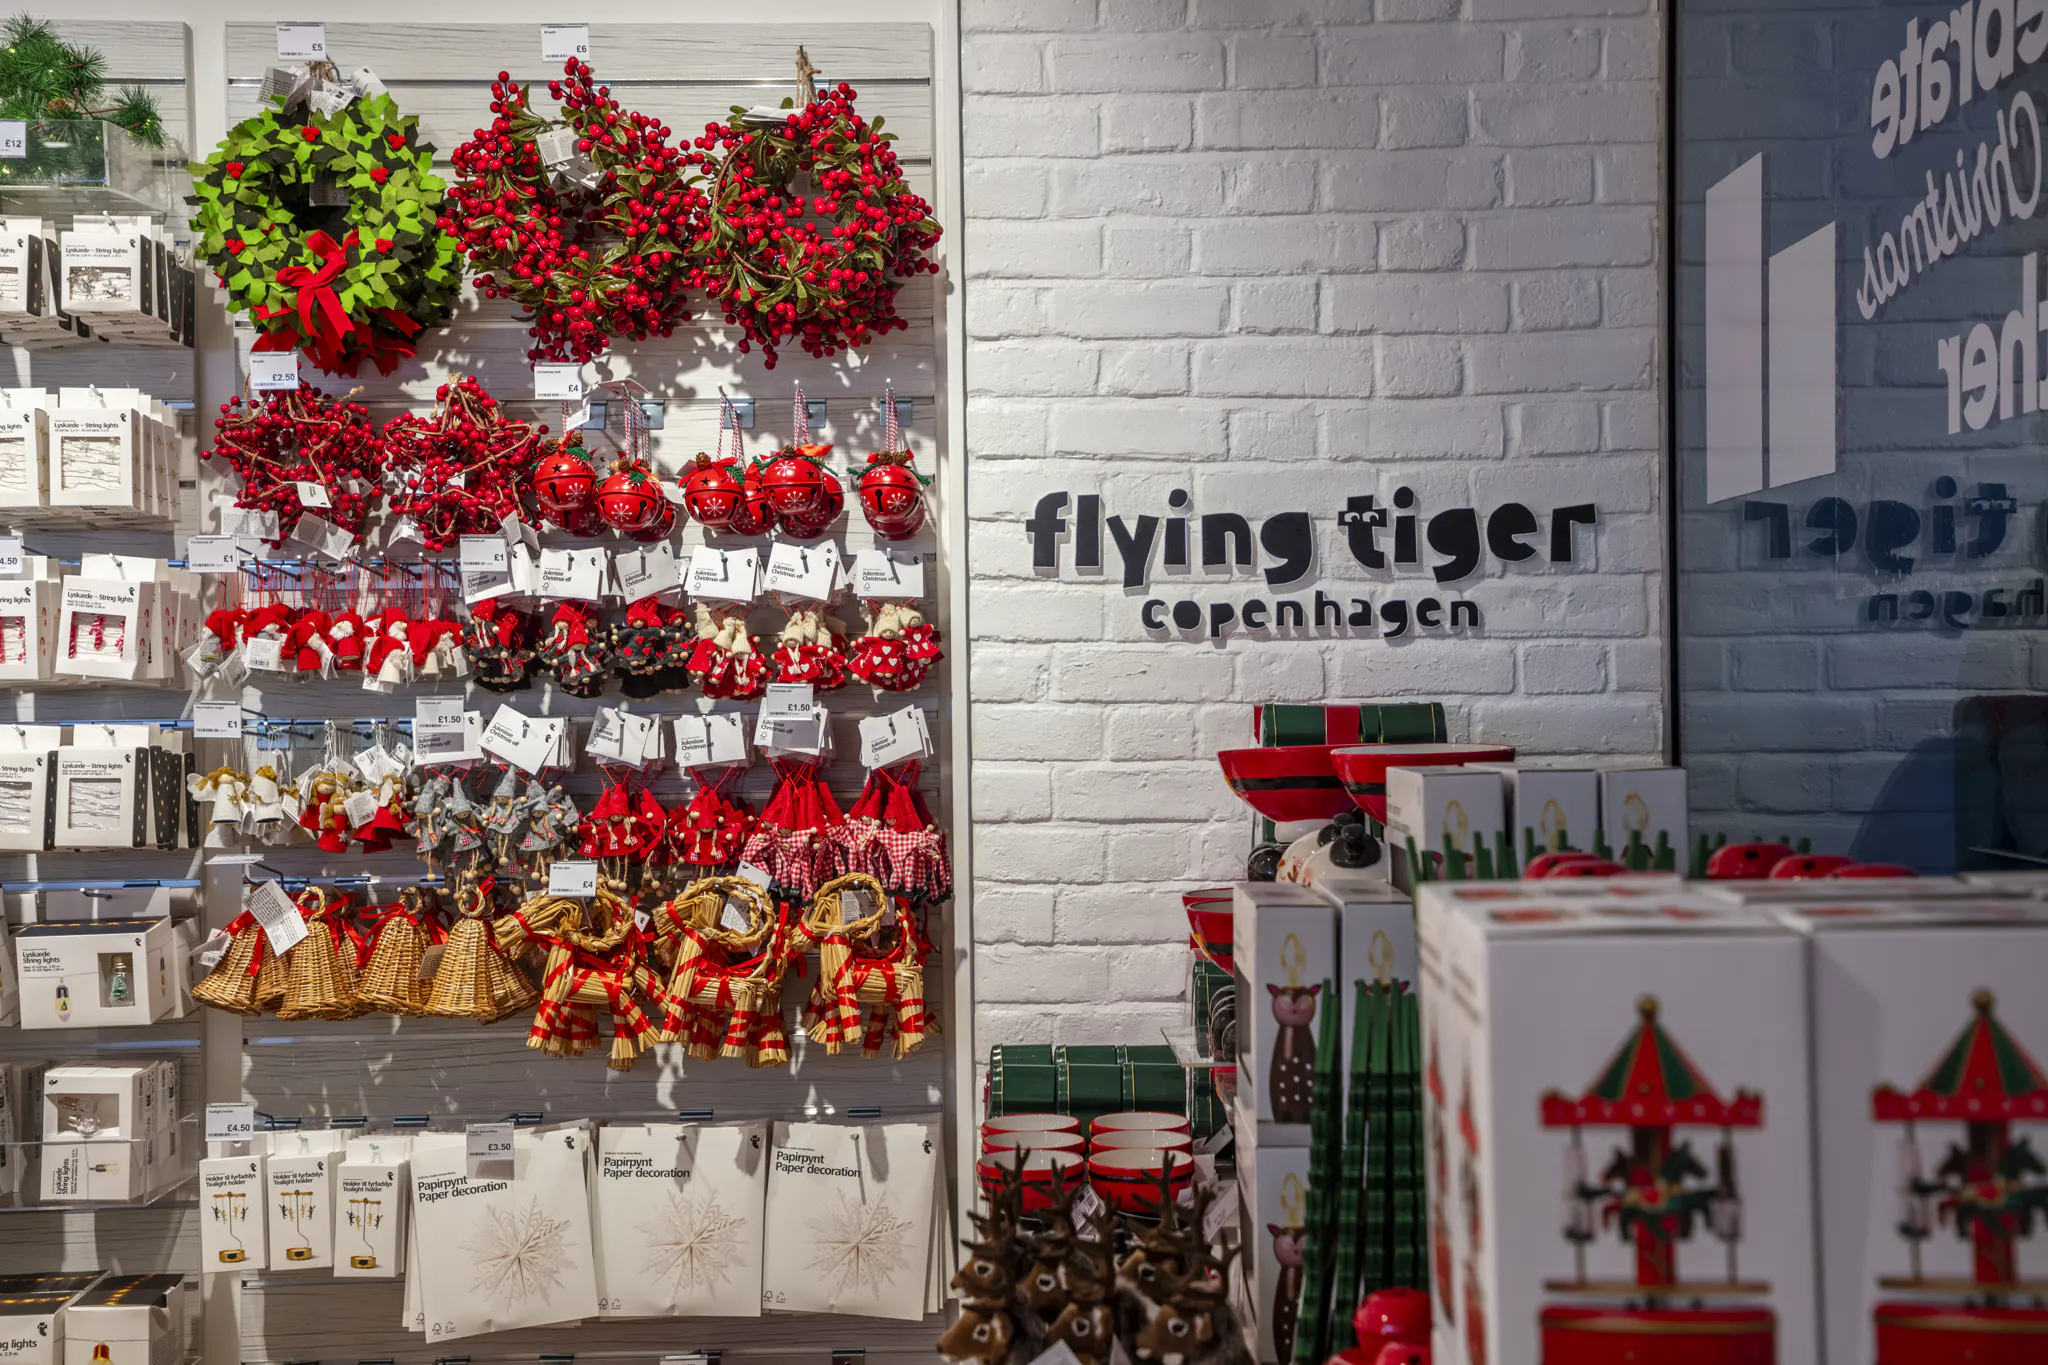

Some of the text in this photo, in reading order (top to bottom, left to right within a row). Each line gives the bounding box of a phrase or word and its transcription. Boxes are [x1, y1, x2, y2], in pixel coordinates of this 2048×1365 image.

[312, 43, 323, 52] £5
[576, 45, 587, 54] £6
[5, 139, 22, 148] £12
[272, 373, 295, 382] £2.50
[568, 384, 579, 392] £4
[1025, 486, 1598, 589] flying tiger
[223, 554, 234, 563] £1
[494, 553, 504, 561] £1
[13, 596, 31, 605] lights
[98, 594, 116, 603] String
[117, 595, 134, 603] lights
[1141, 590, 1481, 639] copenhagen
[788, 703, 811, 712] £1.50
[228, 720, 237, 728] £1
[438, 715, 461, 724] £1.50
[1, 765, 16, 773] String
[19, 766, 35, 774] lights
[583, 881, 593, 889] £4
[22, 956, 60, 965] String lights
[227, 1124, 250, 1132] £4.50
[488, 1143, 511, 1151] £3.50
[776, 1151, 825, 1165] Papirpynt
[604, 1157, 653, 1169] Papirpynt
[603, 1167, 690, 1180] Paper decoration
[775, 1161, 861, 1178] Paper decoration
[206, 1180, 227, 1188] Tealight
[417, 1175, 468, 1192] Papirpynt
[419, 1181, 508, 1203] Paper decoration
[11, 1339, 38, 1351] lights
